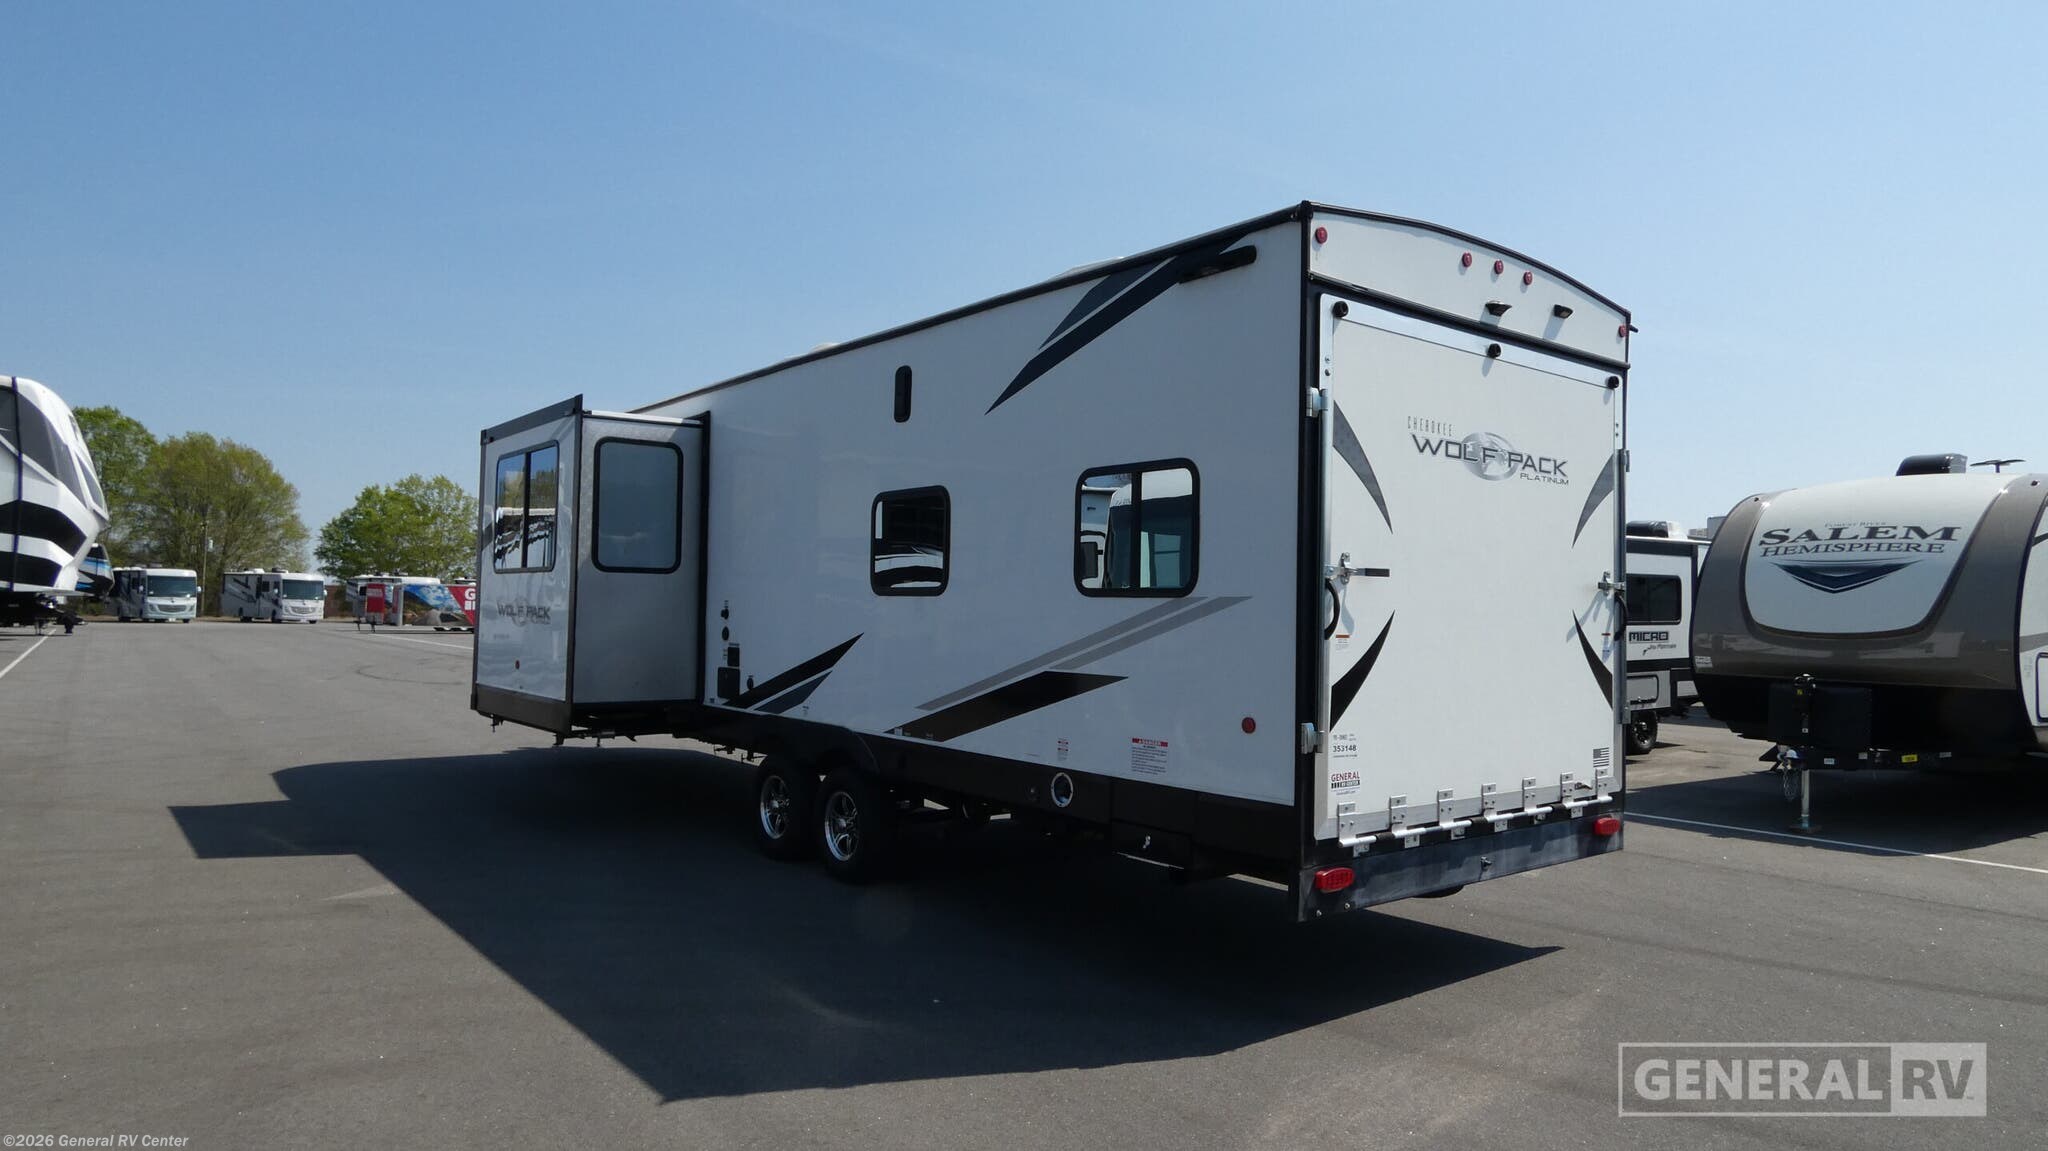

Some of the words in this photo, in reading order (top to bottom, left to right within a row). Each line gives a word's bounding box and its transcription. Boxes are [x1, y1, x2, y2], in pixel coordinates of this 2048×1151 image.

[1407, 415, 1453, 437] CHEROKEE
[1411, 433, 1499, 463] WOLF
[1507, 451, 1568, 478] PACK
[1519, 472, 1570, 486] PLATINUM
[1758, 525, 1962, 546] SALEM
[1759, 542, 1946, 558] HEMISPHERE
[497, 600, 524, 618] WOLF
[526, 605, 551, 621] PACK
[1628, 631, 1669, 642] MICRO
[1331, 771, 1361, 782] GENERAL
